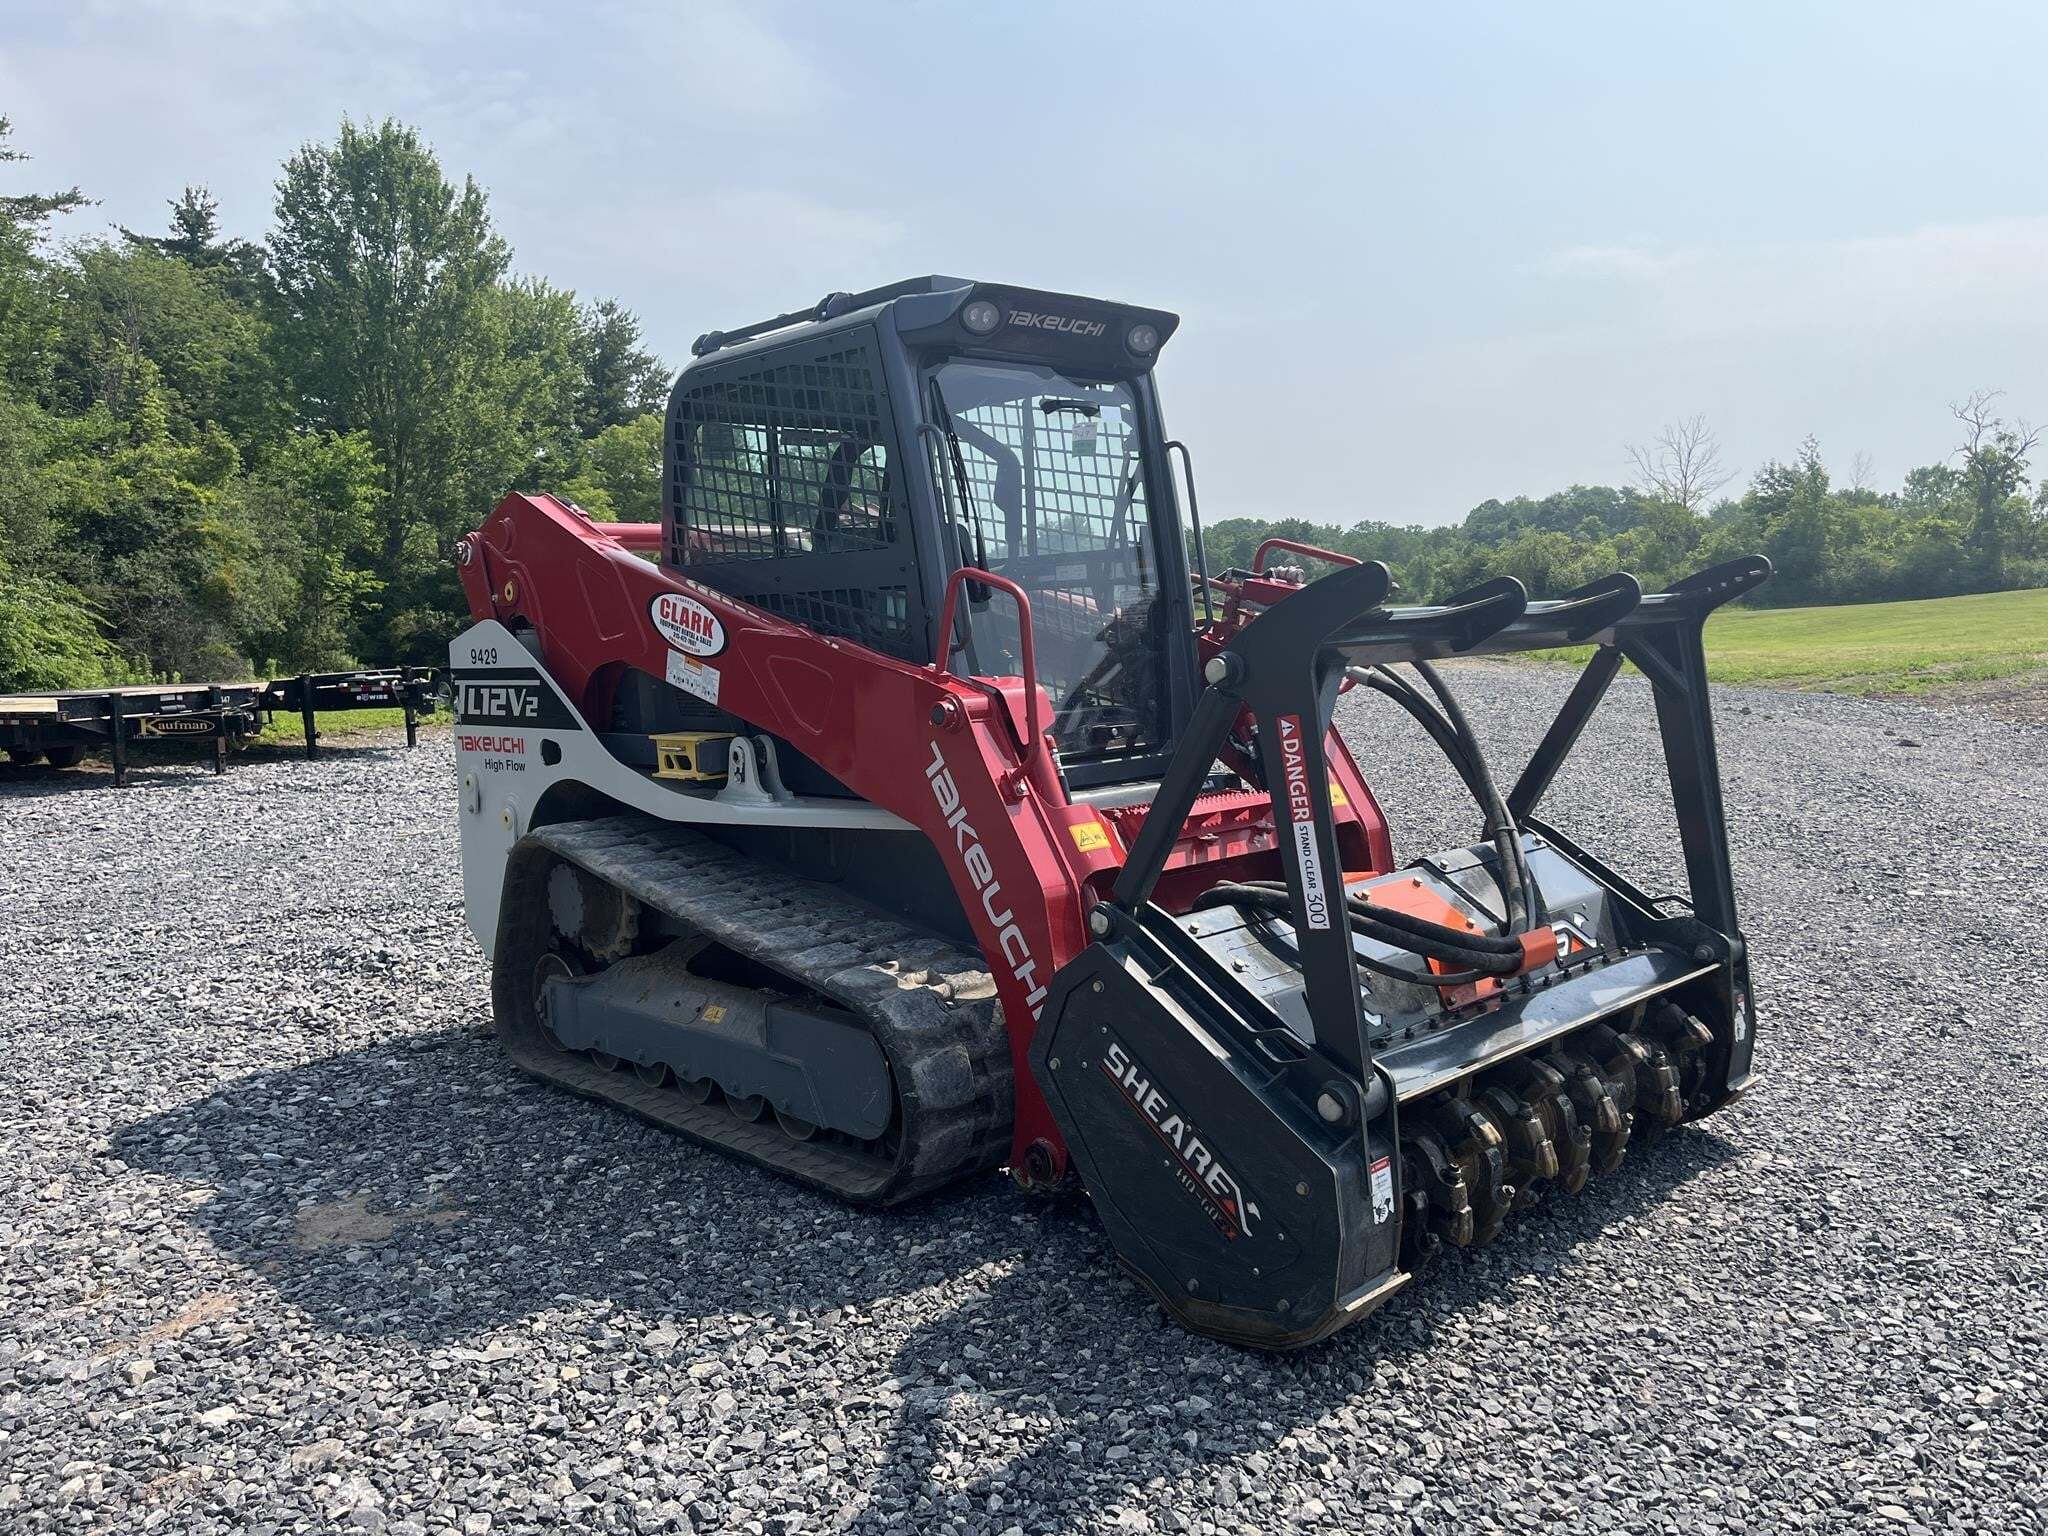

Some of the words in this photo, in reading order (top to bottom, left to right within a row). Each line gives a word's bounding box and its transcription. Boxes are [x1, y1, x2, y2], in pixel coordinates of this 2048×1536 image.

[660, 598, 714, 640] CLARK
[471, 648, 497, 665] 9429
[140, 718, 208, 735] Kaufman
[485, 759, 504, 771] High
[506, 759, 526, 772] Flow
[1282, 738, 1310, 821] DANGER
[1299, 825, 1311, 857] STAND
[1304, 860, 1317, 889] CLEAR
